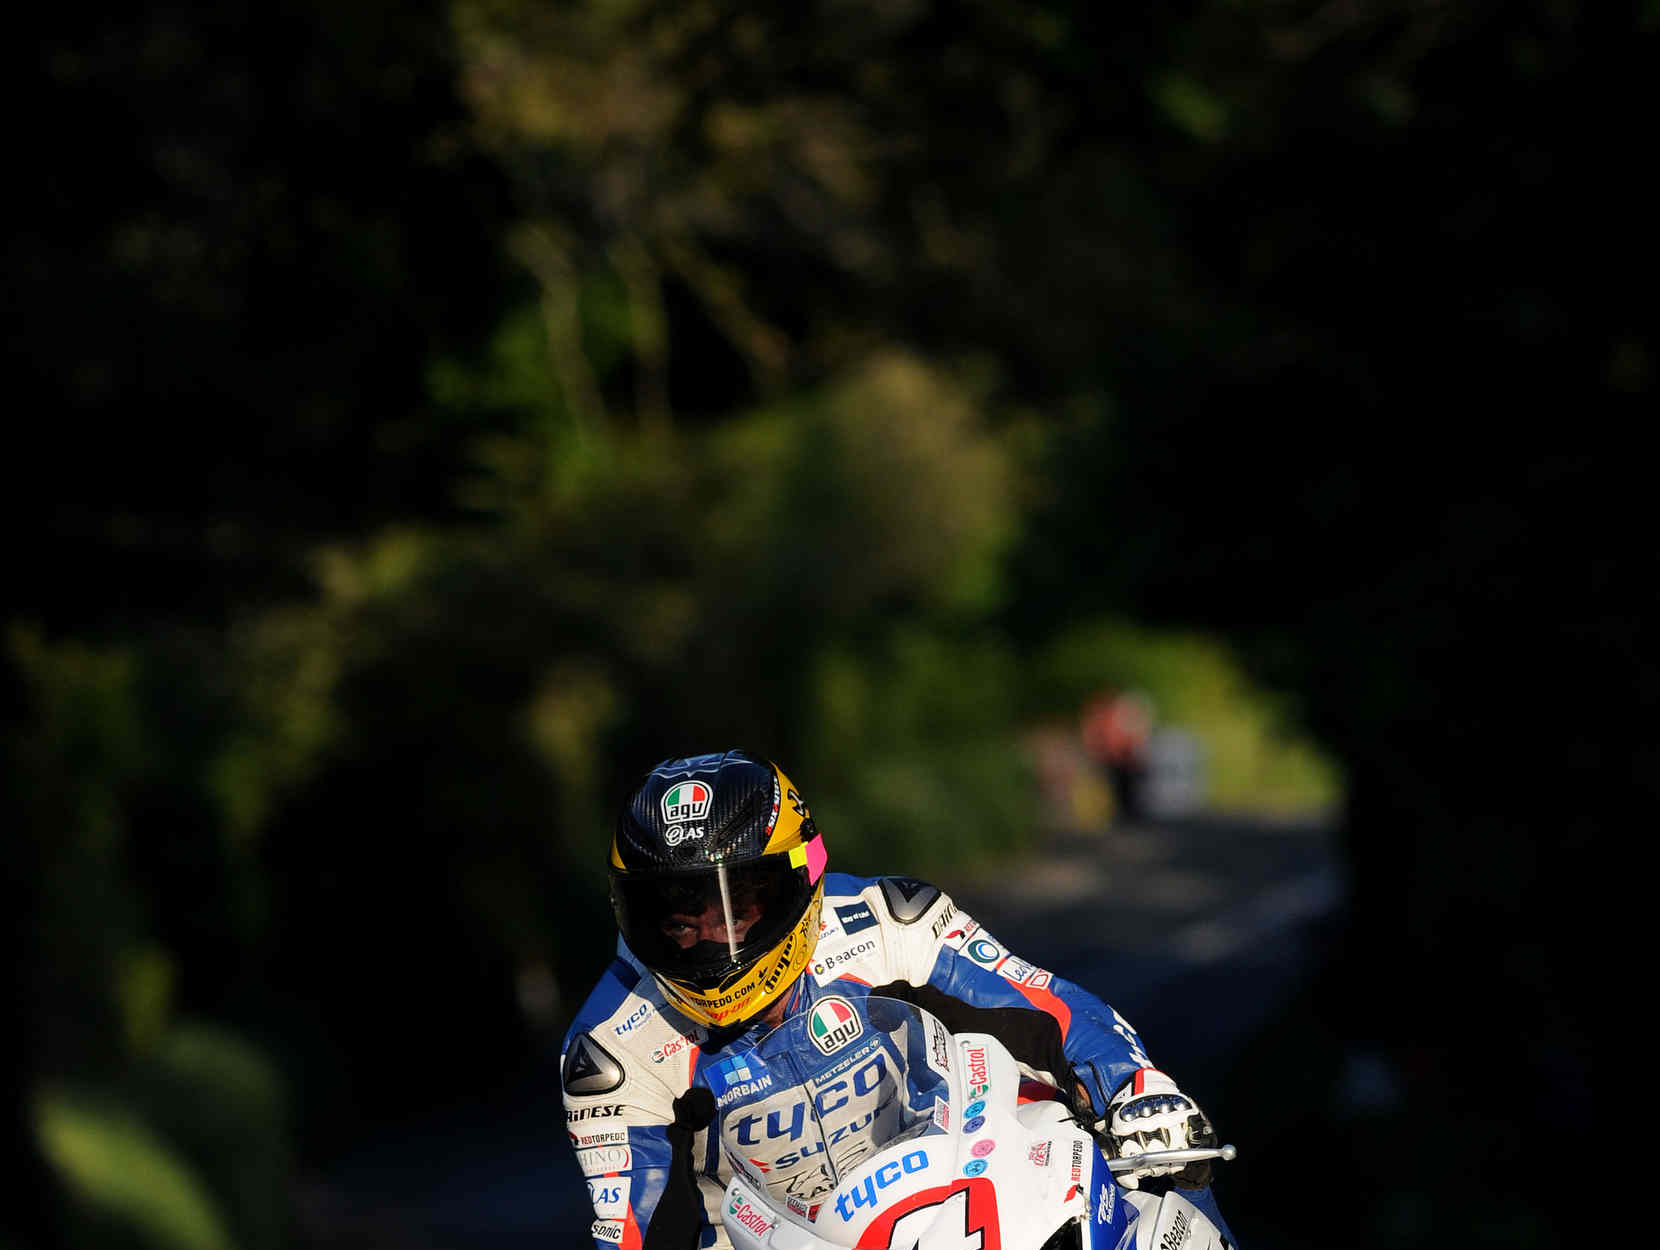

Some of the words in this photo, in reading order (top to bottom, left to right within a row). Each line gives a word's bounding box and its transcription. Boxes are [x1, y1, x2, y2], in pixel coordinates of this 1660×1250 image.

[825, 940, 876, 969] Beacon
[615, 1003, 647, 1036] tyco
[663, 1030, 699, 1057] Castrol
[967, 1047, 988, 1086] Castrol
[730, 1053, 888, 1146] tyco
[1071, 1140, 1083, 1181] REDTORPEDO
[834, 1150, 929, 1222] tyco
[736, 1204, 772, 1237] Castrol
